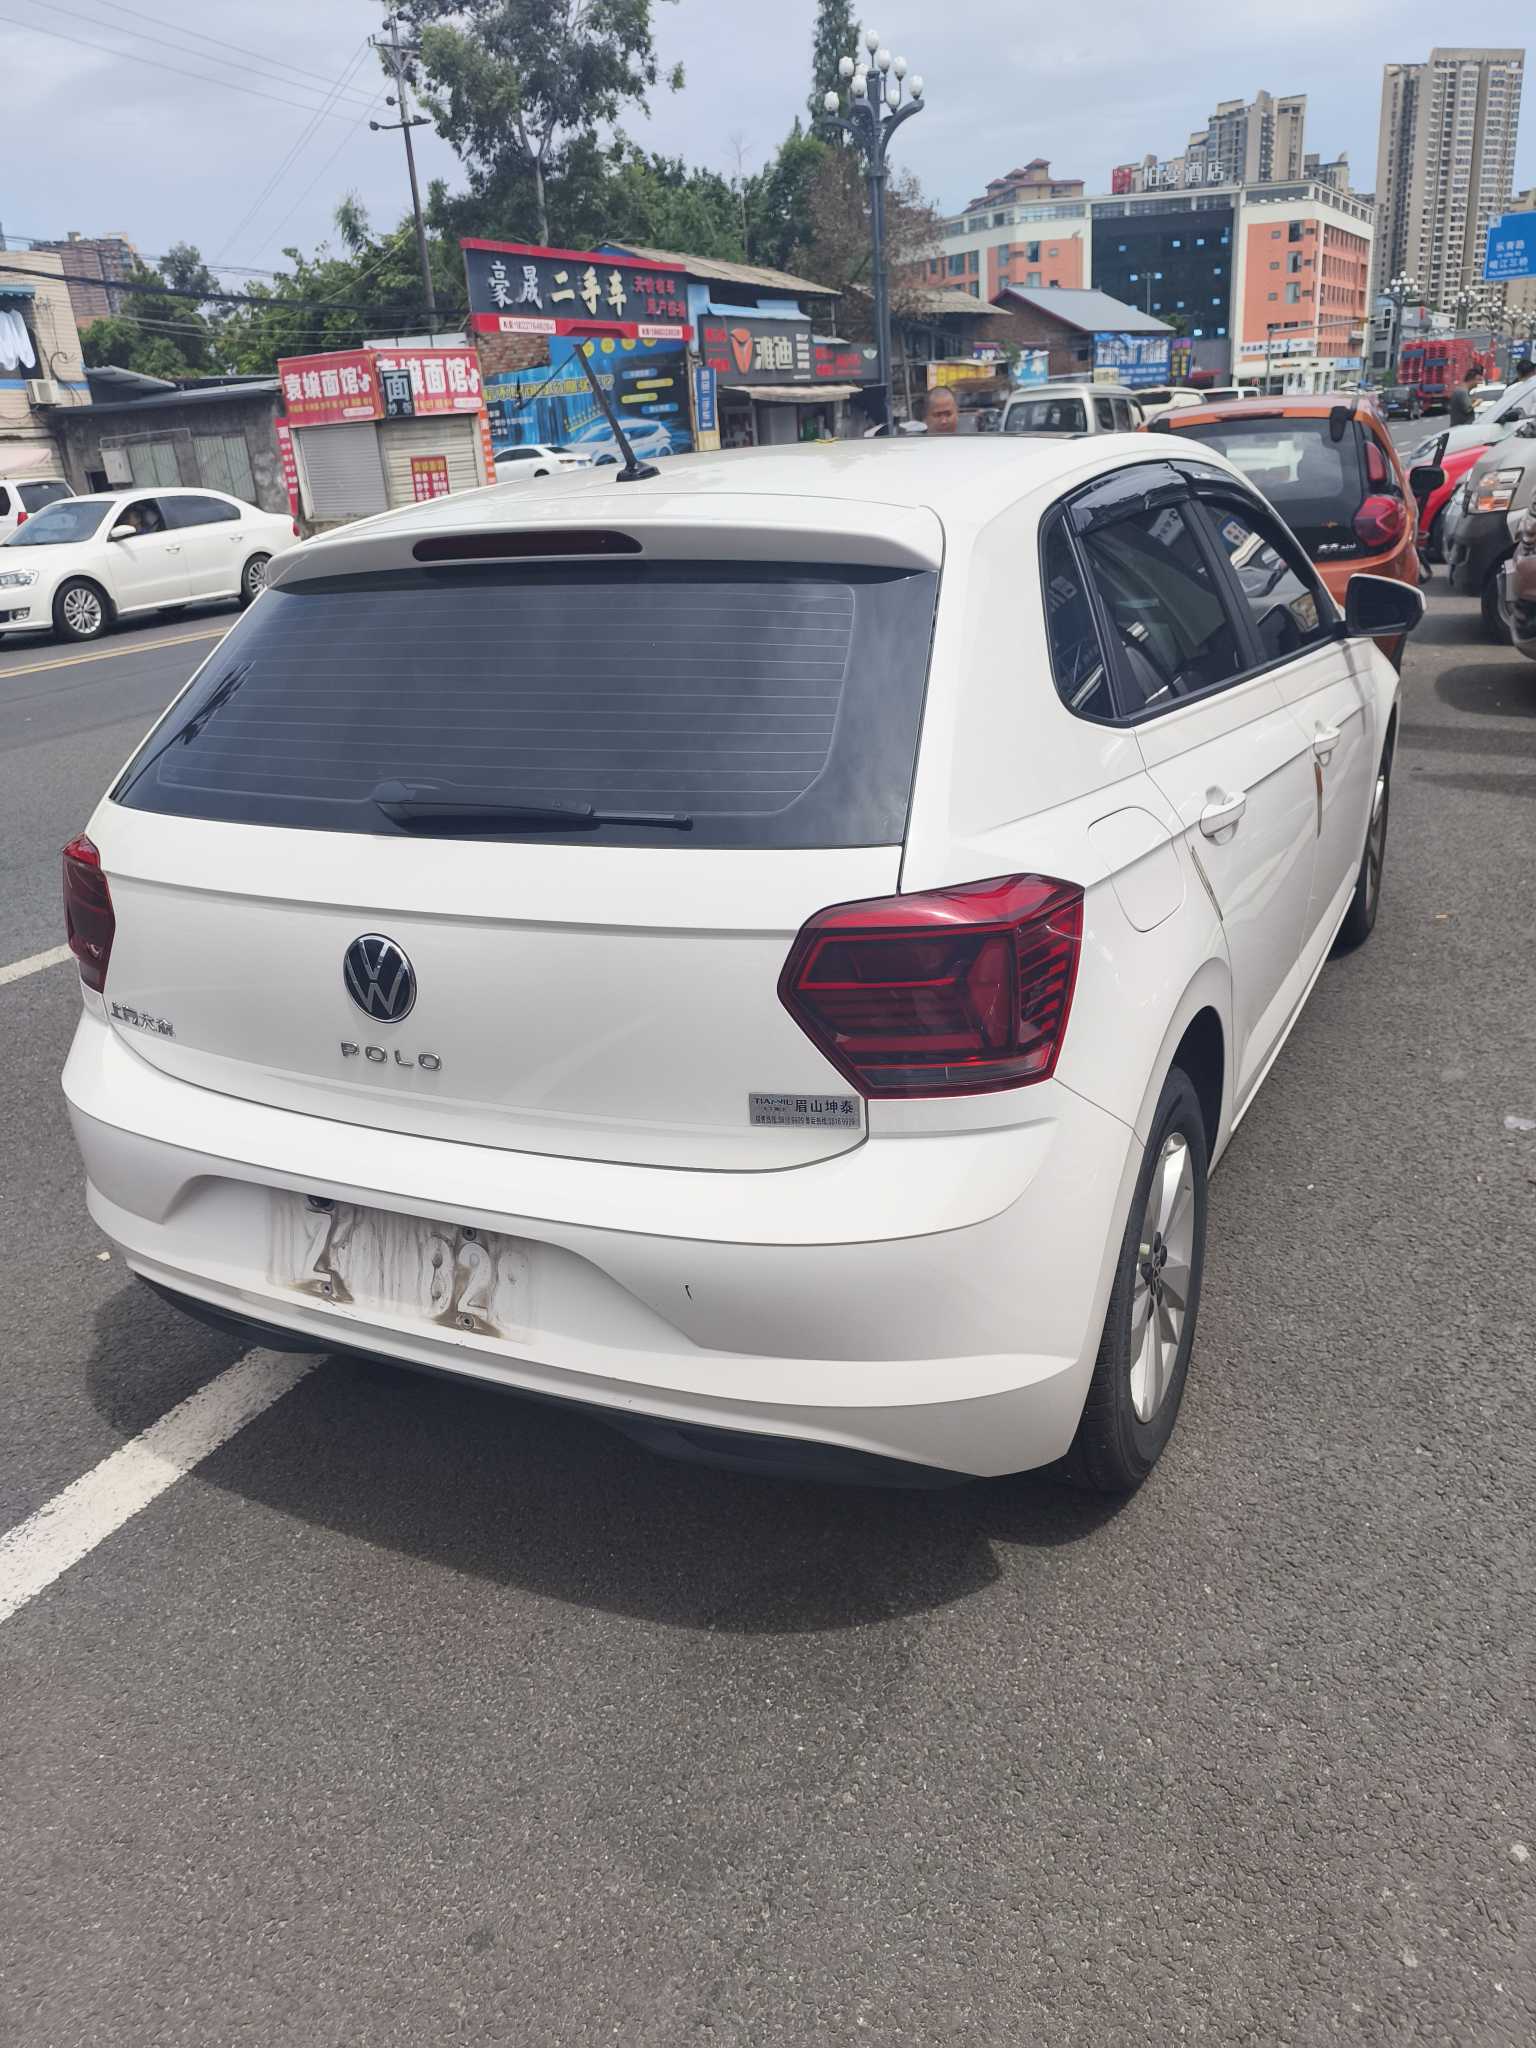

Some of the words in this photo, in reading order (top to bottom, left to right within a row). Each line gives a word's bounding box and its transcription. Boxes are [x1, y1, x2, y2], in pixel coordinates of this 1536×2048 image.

[754, 336, 793, 370] 雅迪
[341, 1041, 442, 1071] POLO
[795, 1099, 854, 1114] 眉山坤泰
